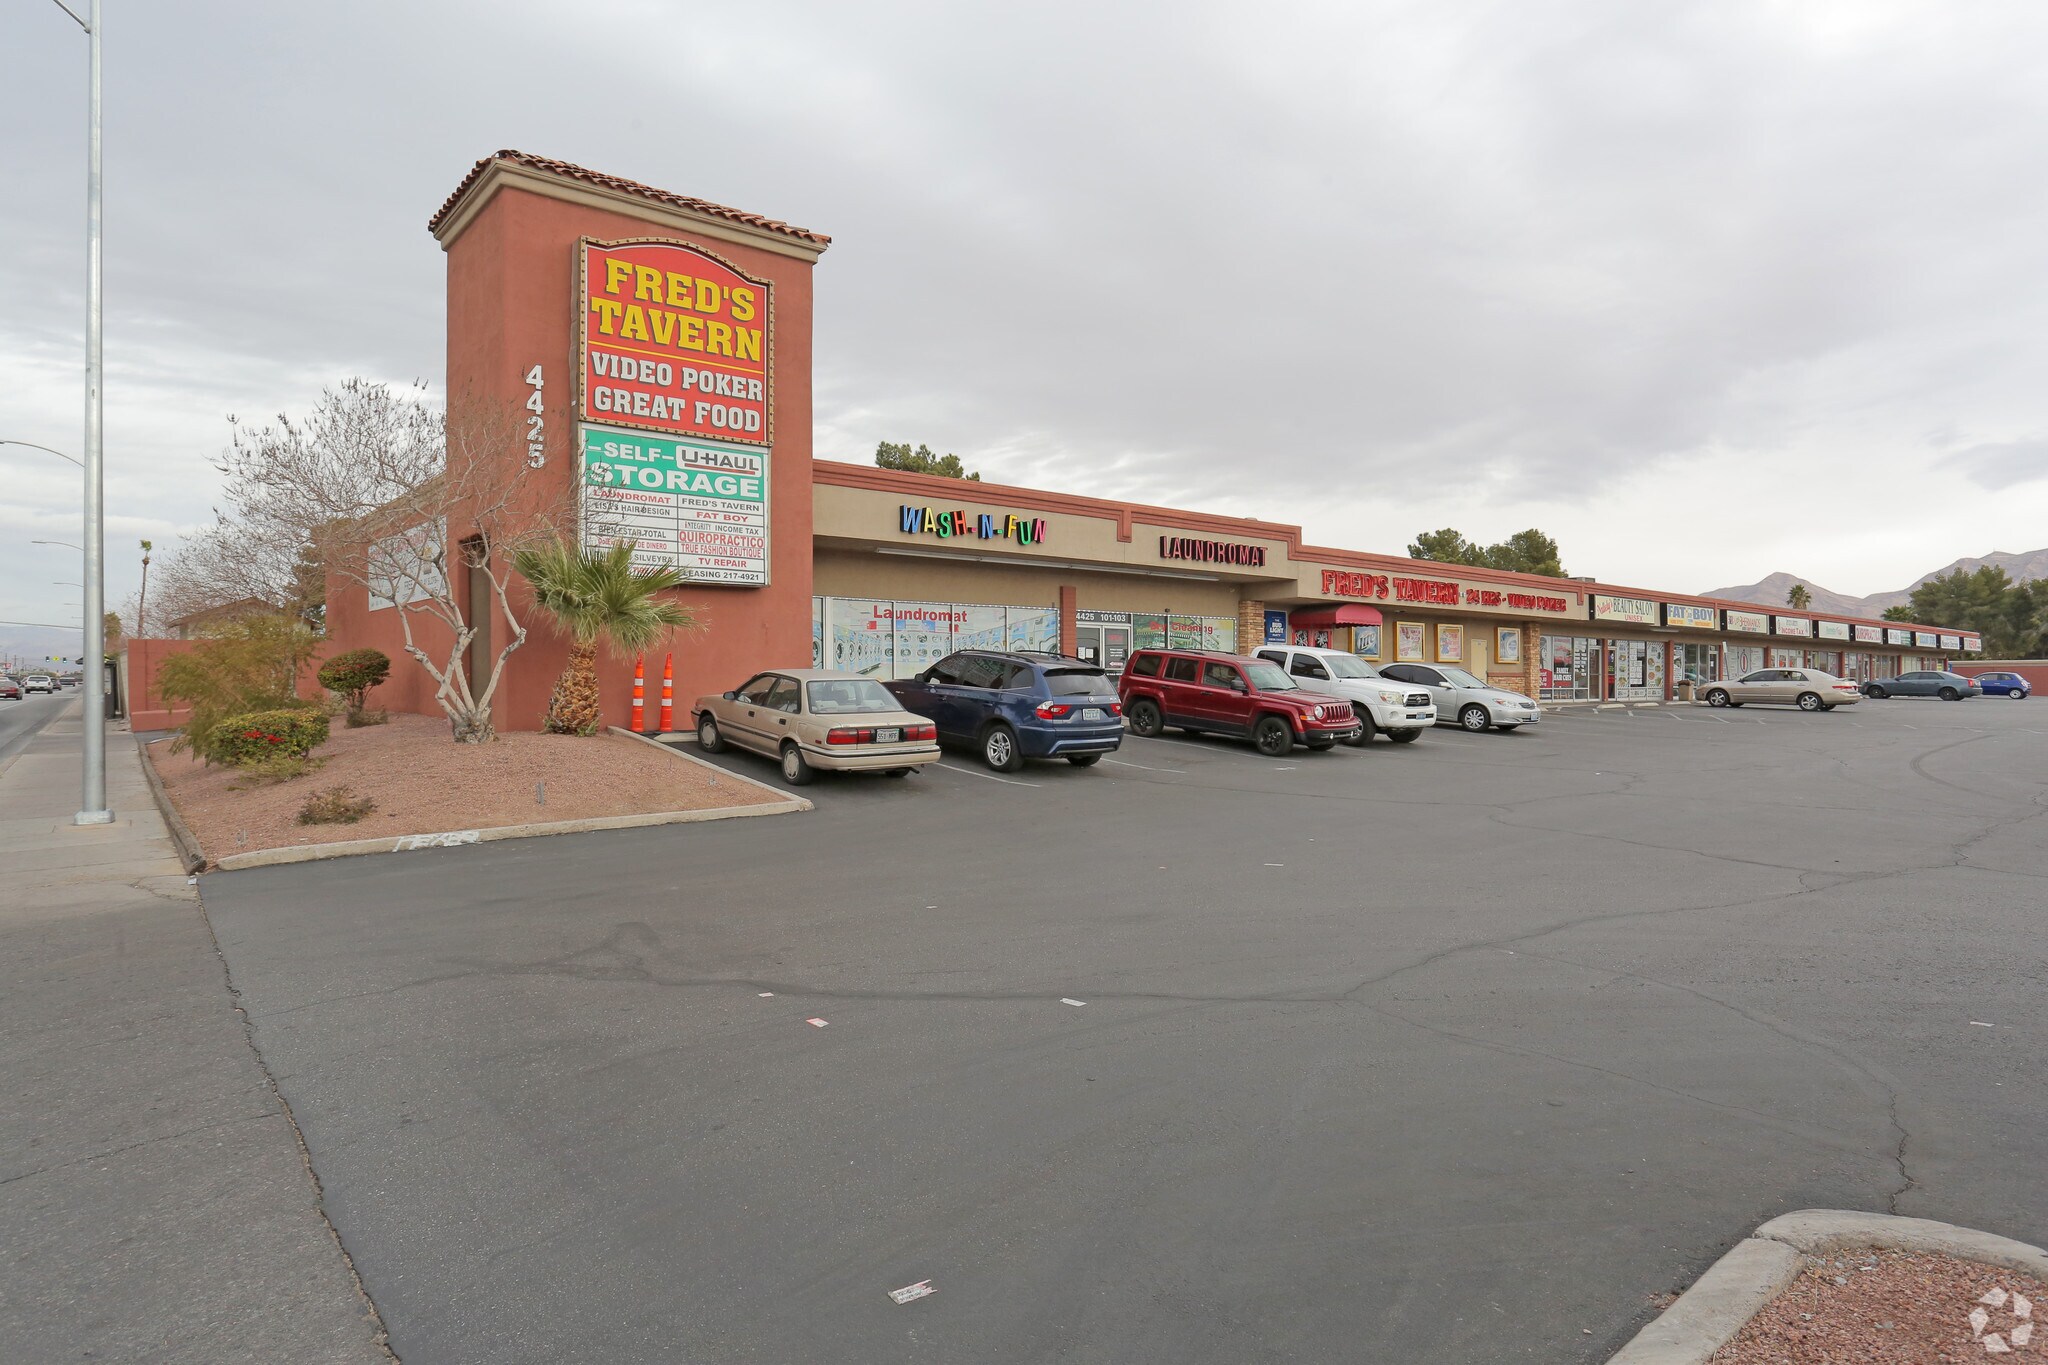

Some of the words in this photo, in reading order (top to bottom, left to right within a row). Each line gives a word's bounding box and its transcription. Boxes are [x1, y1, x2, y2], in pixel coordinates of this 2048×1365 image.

[606, 257, 755, 321] FRED'S
[591, 297, 761, 362] TAVERN
[591, 351, 672, 386] VIDEO
[682, 367, 762, 401] POKER
[525, 364, 545, 469] 4425
[594, 386, 685, 420] GREAT
[695, 401, 760, 432] FOOD
[590, 462, 760, 498] STORAGE
[594, 490, 671, 504] LAUNDROMAT
[682, 498, 718, 508] FRED'S
[721, 501, 760, 512] TAVERN
[621, 505, 640, 513] HAIR
[696, 511, 719, 520] FAT
[723, 514, 748, 522] BOY
[715, 525, 744, 534] INCOME
[745, 527, 759, 535] TAX
[646, 542, 668, 550] DINERO
[679, 531, 764, 548] QUIROPRACTICO
[681, 543, 698, 553] TRUE
[700, 544, 728, 556] FASHION
[730, 547, 761, 558] BOUTIQUE
[1160, 536, 1268, 567] LAUNDROMAT
[698, 557, 711, 565] TV
[714, 558, 747, 568] REPAIR
[684, 570, 721, 578] LEASING
[723, 572, 760, 581] 217-4921
[1321, 570, 1389, 599] FRED'S
[1393, 577, 1459, 605] TAVERN
[873, 604, 967, 623] Laundromat
[1100, 614, 1126, 622] 101-103
[1668, 605, 1686, 618] FAT
[1693, 608, 1713, 621] BOY
